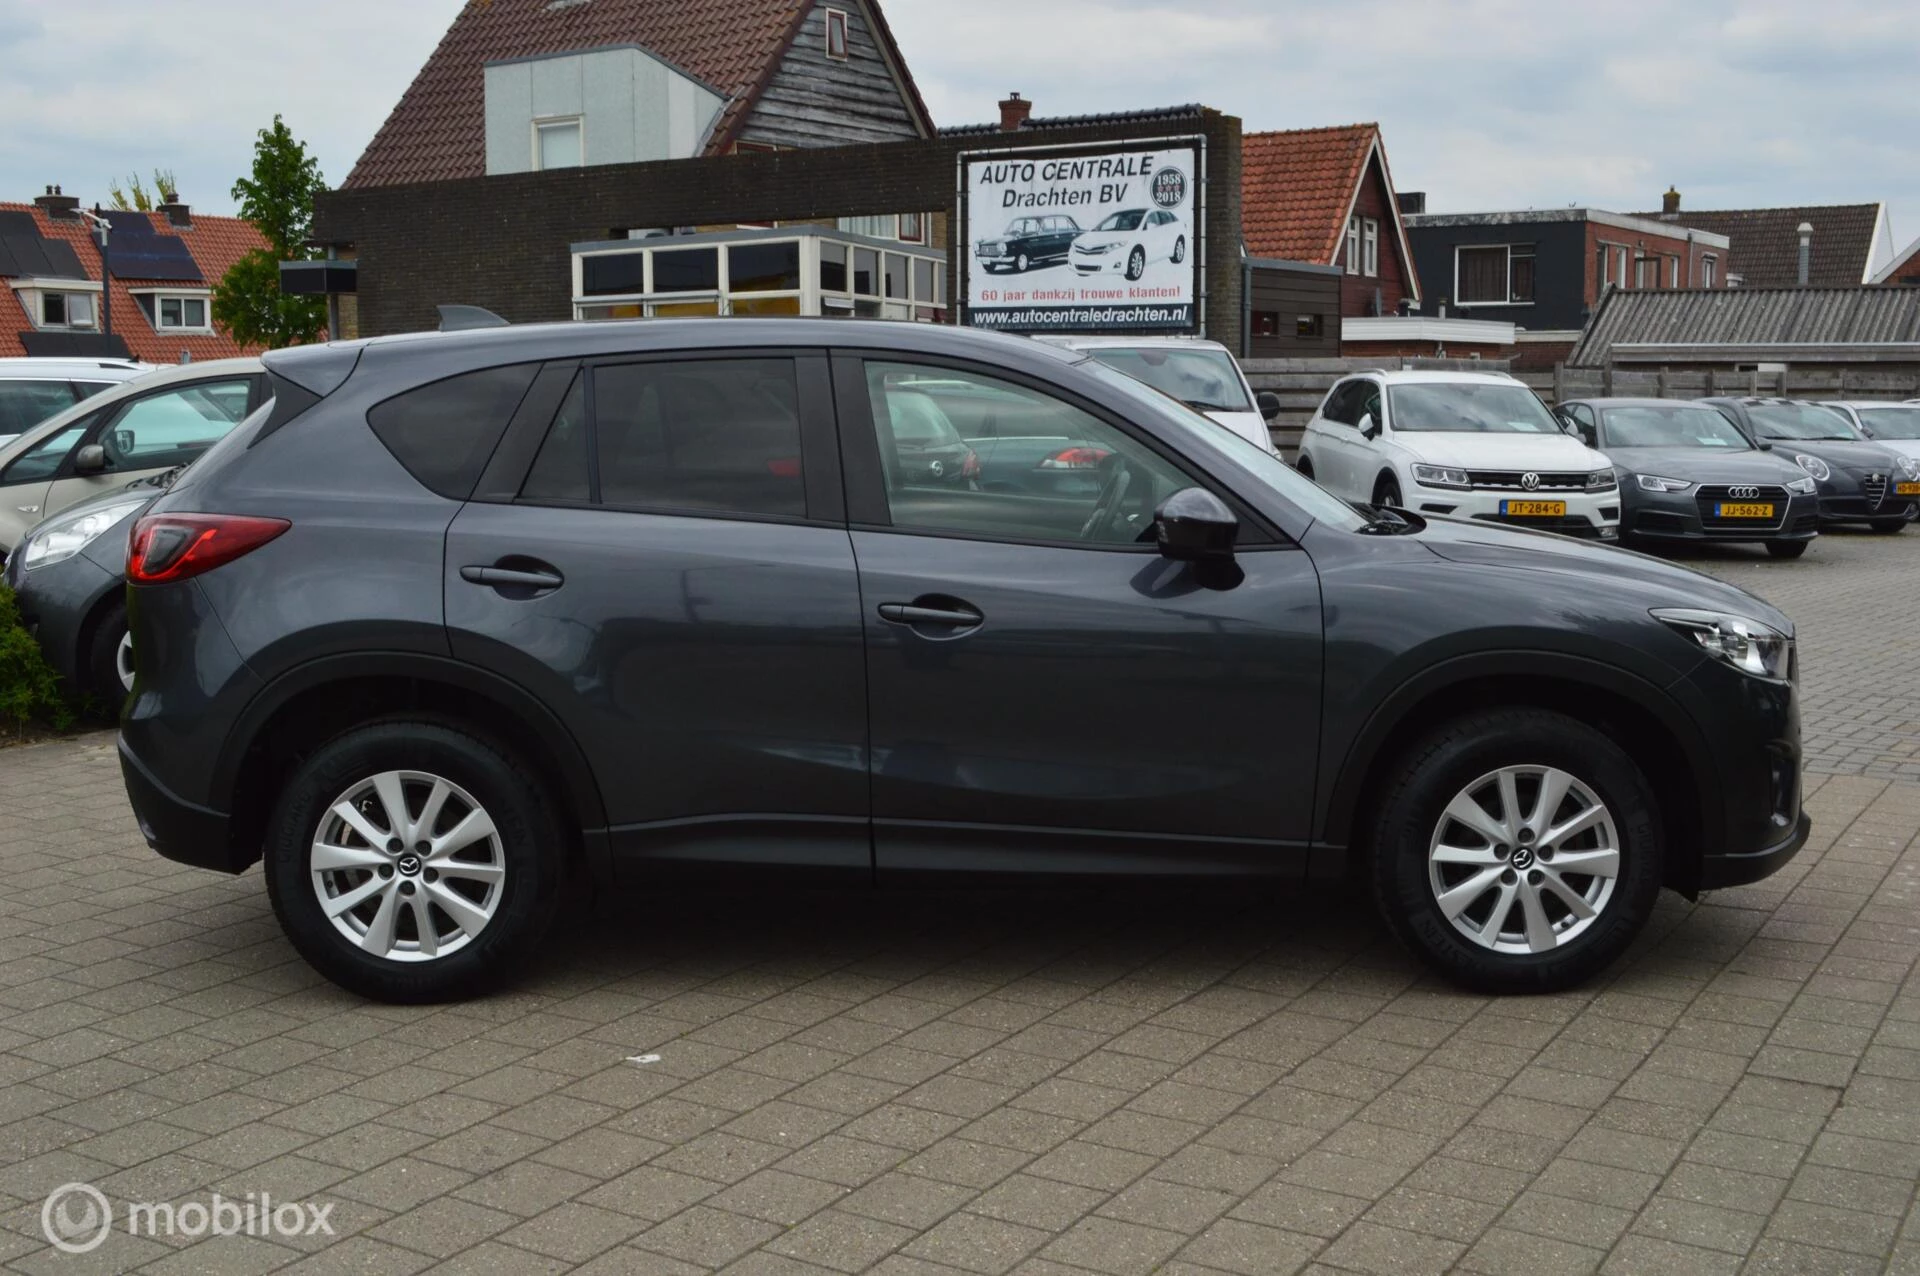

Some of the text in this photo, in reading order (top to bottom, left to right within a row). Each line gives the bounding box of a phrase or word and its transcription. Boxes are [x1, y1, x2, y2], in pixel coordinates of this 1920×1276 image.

[980, 156, 1154, 184] AUTO CENTRALE
[1157, 173, 1181, 185] 1958
[1002, 183, 1128, 208] Drachten BV
[1156, 191, 1181, 203] 2018
[981, 286, 1180, 302] 60 jaar dankzij trouwe klanten!
[974, 306, 1188, 324] www.autocentraledrachten.nl
[1512, 503, 1561, 514] JT-284-G
[1725, 506, 1768, 515] JJ-562-Z
